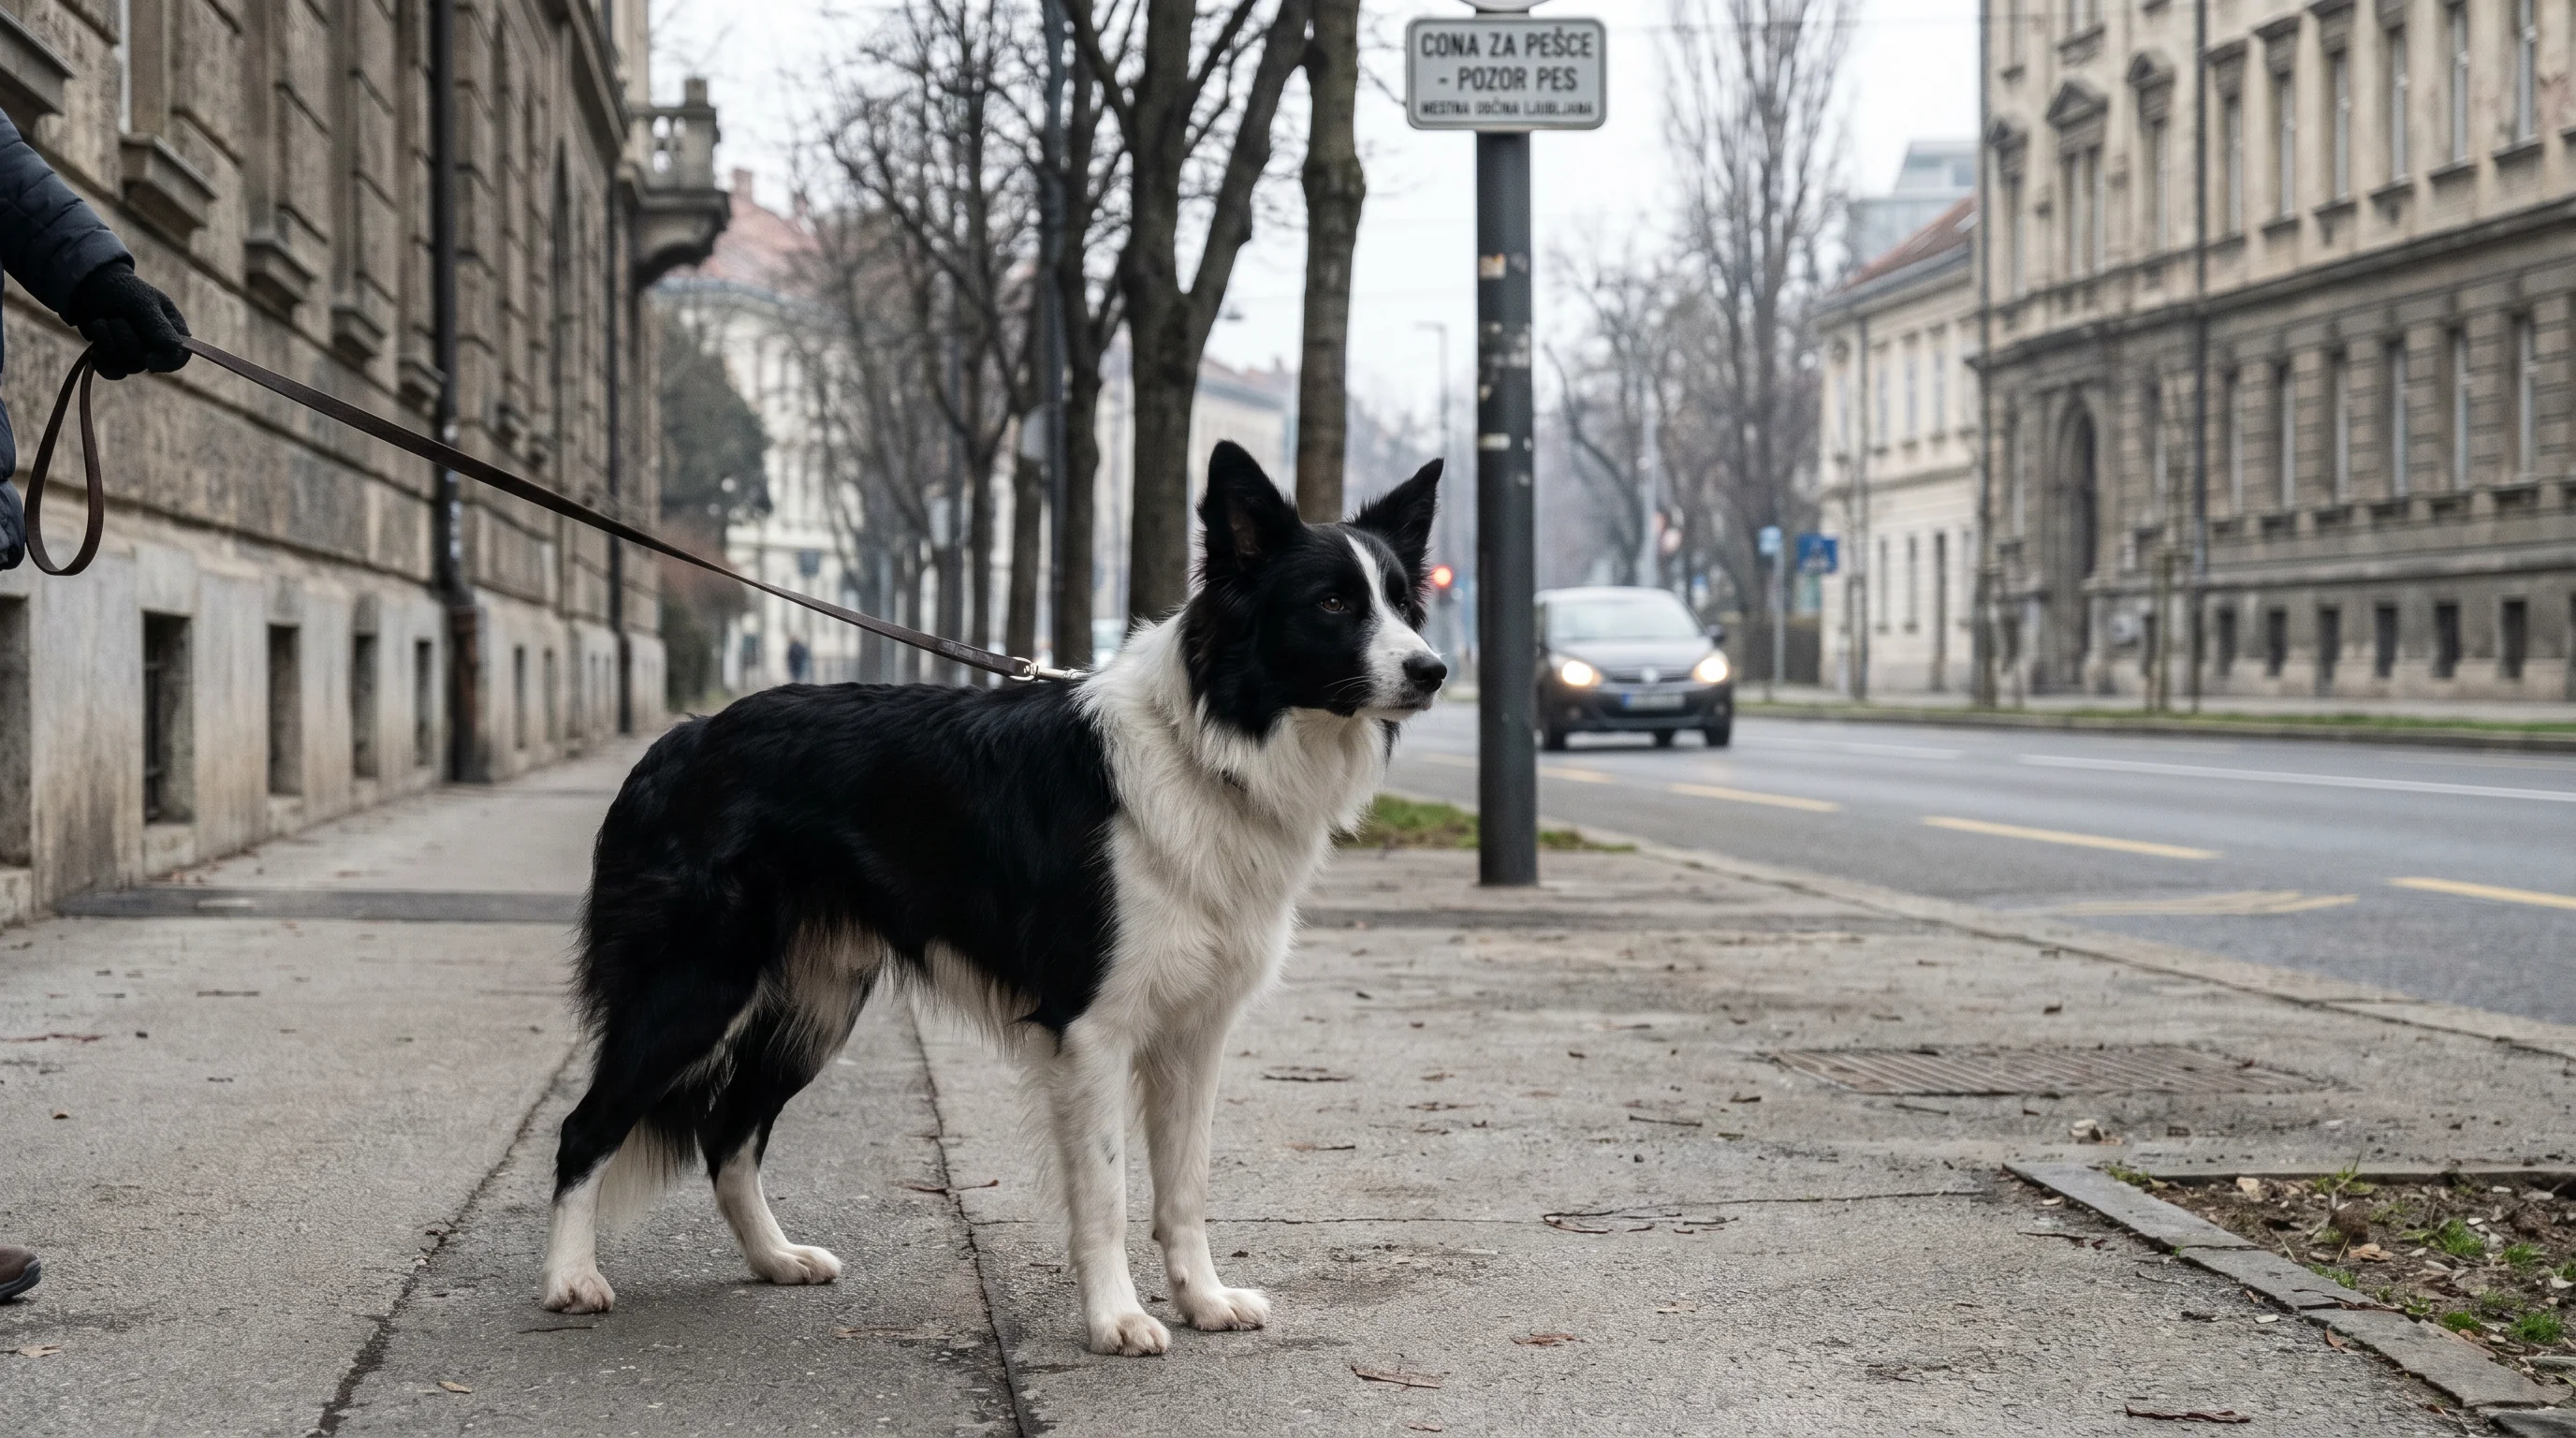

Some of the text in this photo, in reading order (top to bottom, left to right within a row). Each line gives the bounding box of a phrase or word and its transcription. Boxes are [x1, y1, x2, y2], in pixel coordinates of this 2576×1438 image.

[1421, 26, 1592, 57] CONA ZA PEŠCE
[1457, 66, 1528, 91] POZOR
[1537, 66, 1578, 91] PES
